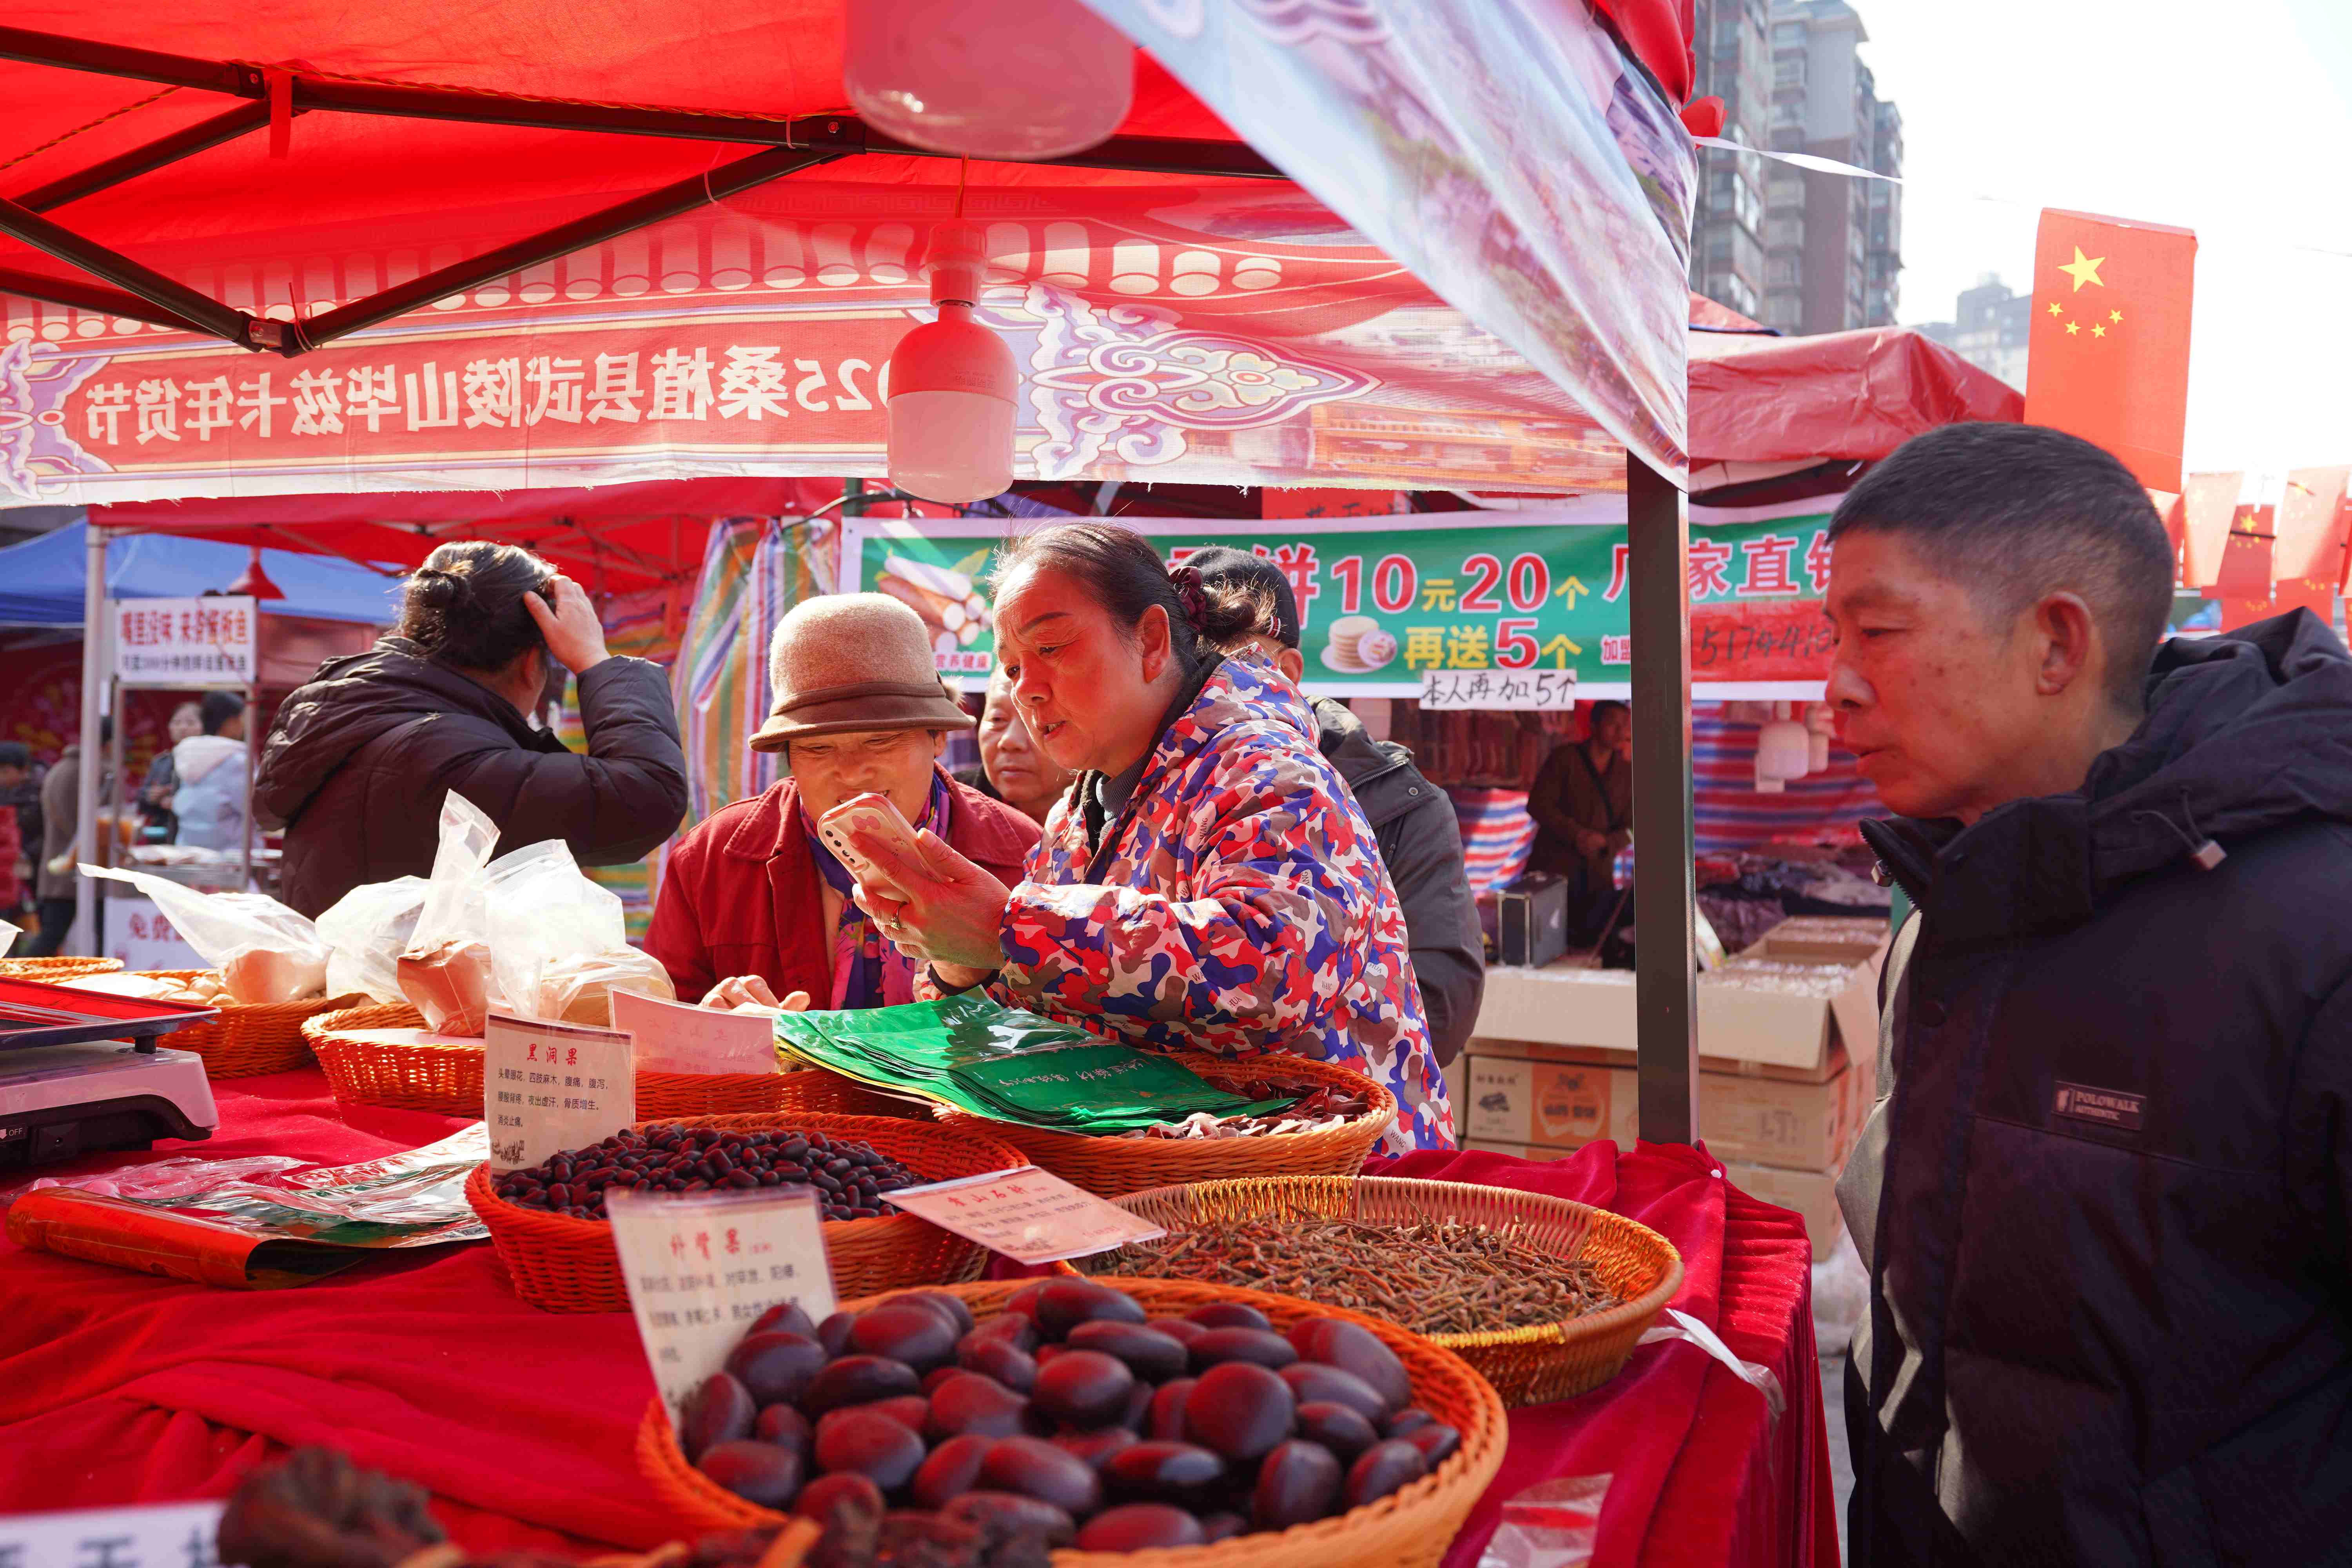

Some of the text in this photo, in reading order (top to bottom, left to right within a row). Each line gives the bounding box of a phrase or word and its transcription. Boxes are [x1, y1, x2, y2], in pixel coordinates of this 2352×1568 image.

[1405, 618, 1582, 670] 再送5个
[1199, 818, 1208, 840] WANG
[1369, 963, 1382, 973] HUA
[1321, 980, 1332, 991] WANG
[1228, 996, 1242, 1008] HUA
[9, 1127, 24, 1136] OFF
[1390, 1129, 1407, 1149] WANG
